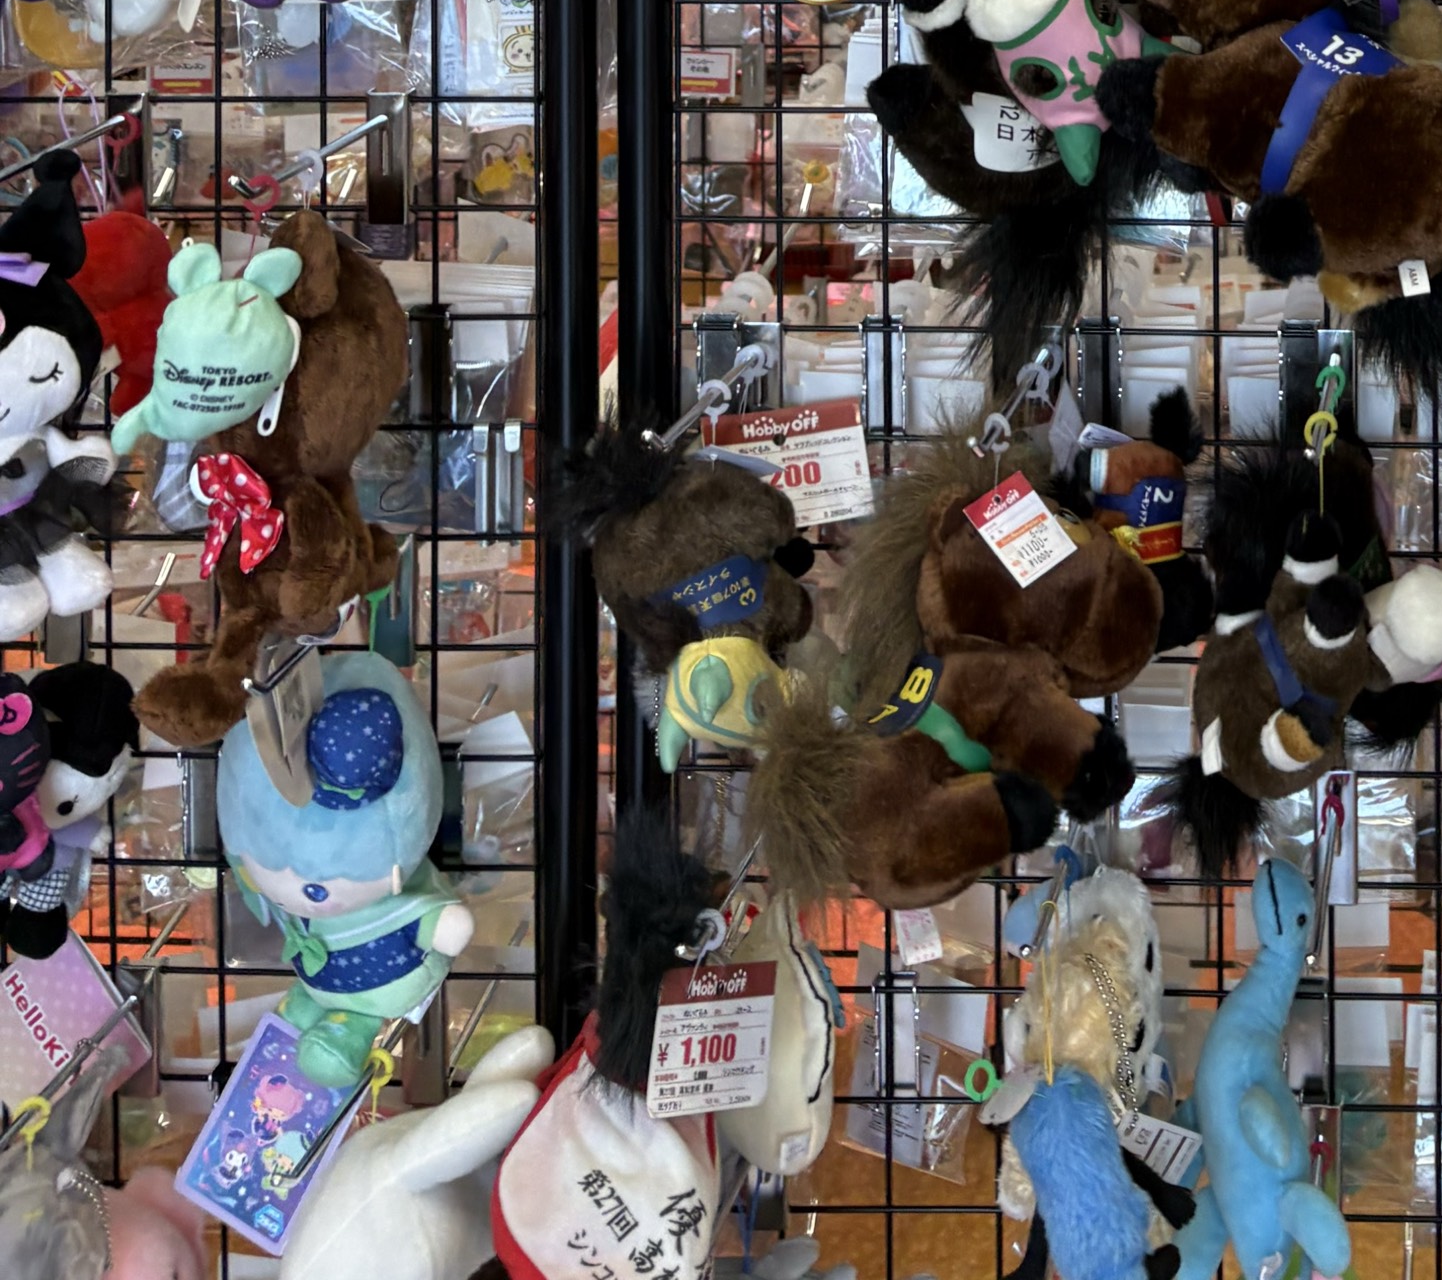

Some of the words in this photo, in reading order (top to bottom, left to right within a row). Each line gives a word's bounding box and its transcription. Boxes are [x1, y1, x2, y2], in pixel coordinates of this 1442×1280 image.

[1321, 34, 1365, 65] 13
[1154, 486, 1175, 504] 2
[739, 586, 757, 607] 3
[656, 1042, 670, 1067] ¥
[681, 1033, 737, 1068] 1,100
[577, 1168, 639, 1243] 第27回
